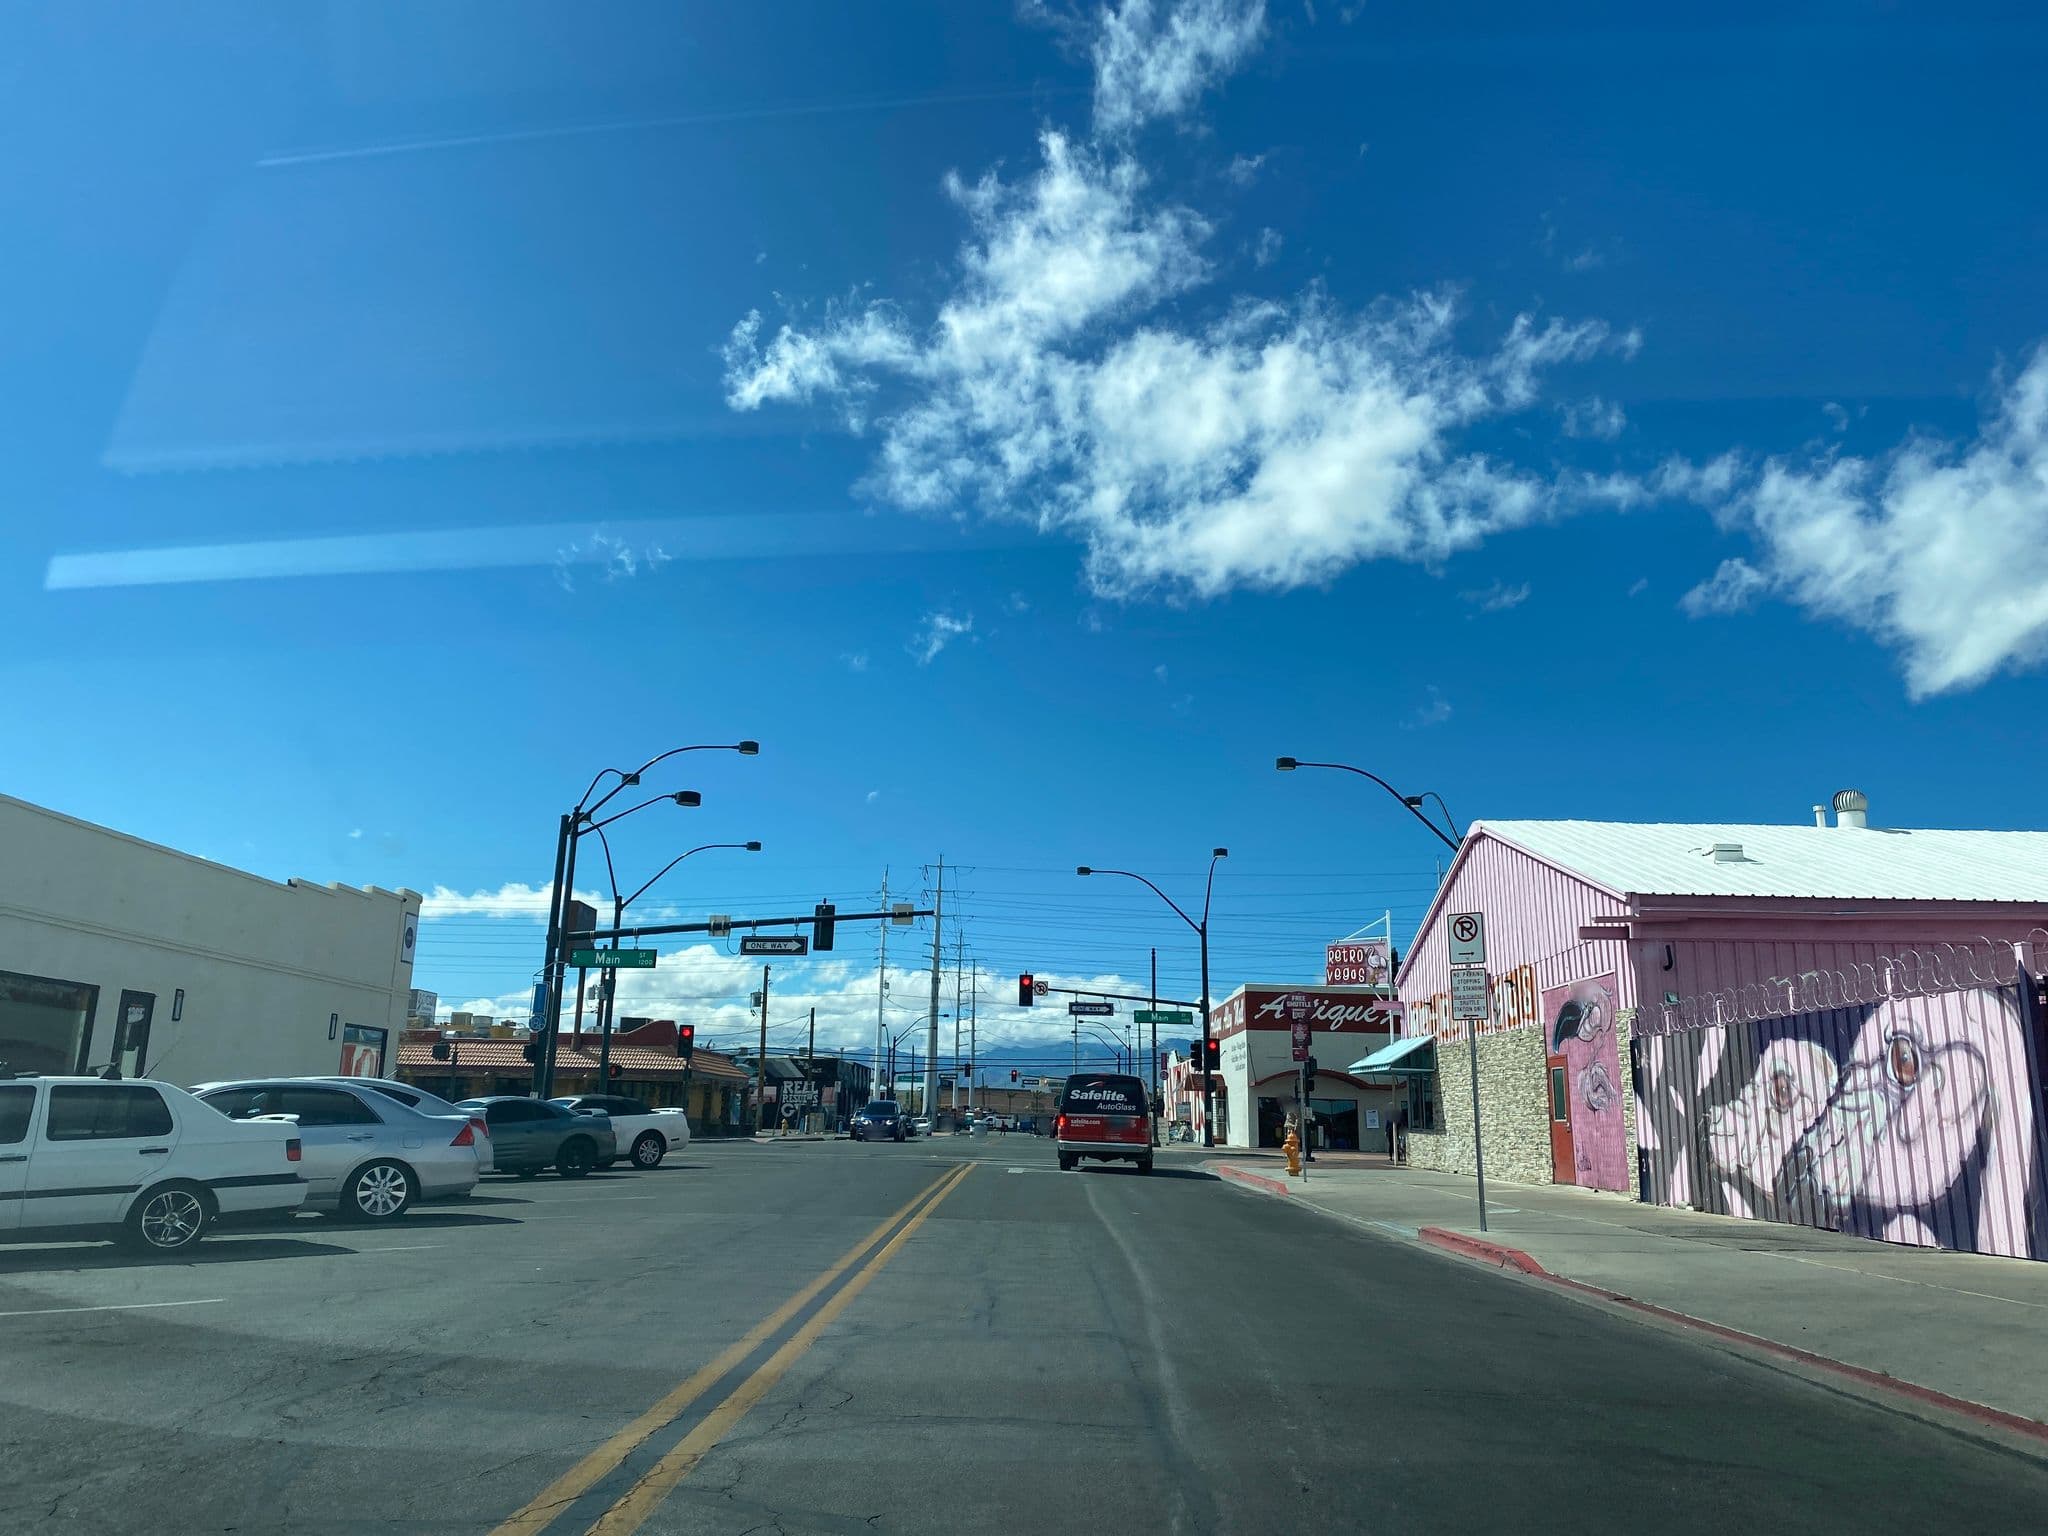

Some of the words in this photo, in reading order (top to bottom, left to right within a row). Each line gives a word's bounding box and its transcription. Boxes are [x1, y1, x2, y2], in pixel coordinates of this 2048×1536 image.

[595, 952, 620, 965] Main
[1151, 1013, 1169, 1021] Main
[1254, 994, 1390, 1031] Aique
[783, 1080, 819, 1094] REAL
[1096, 1102, 1137, 1111] AutoGlass
